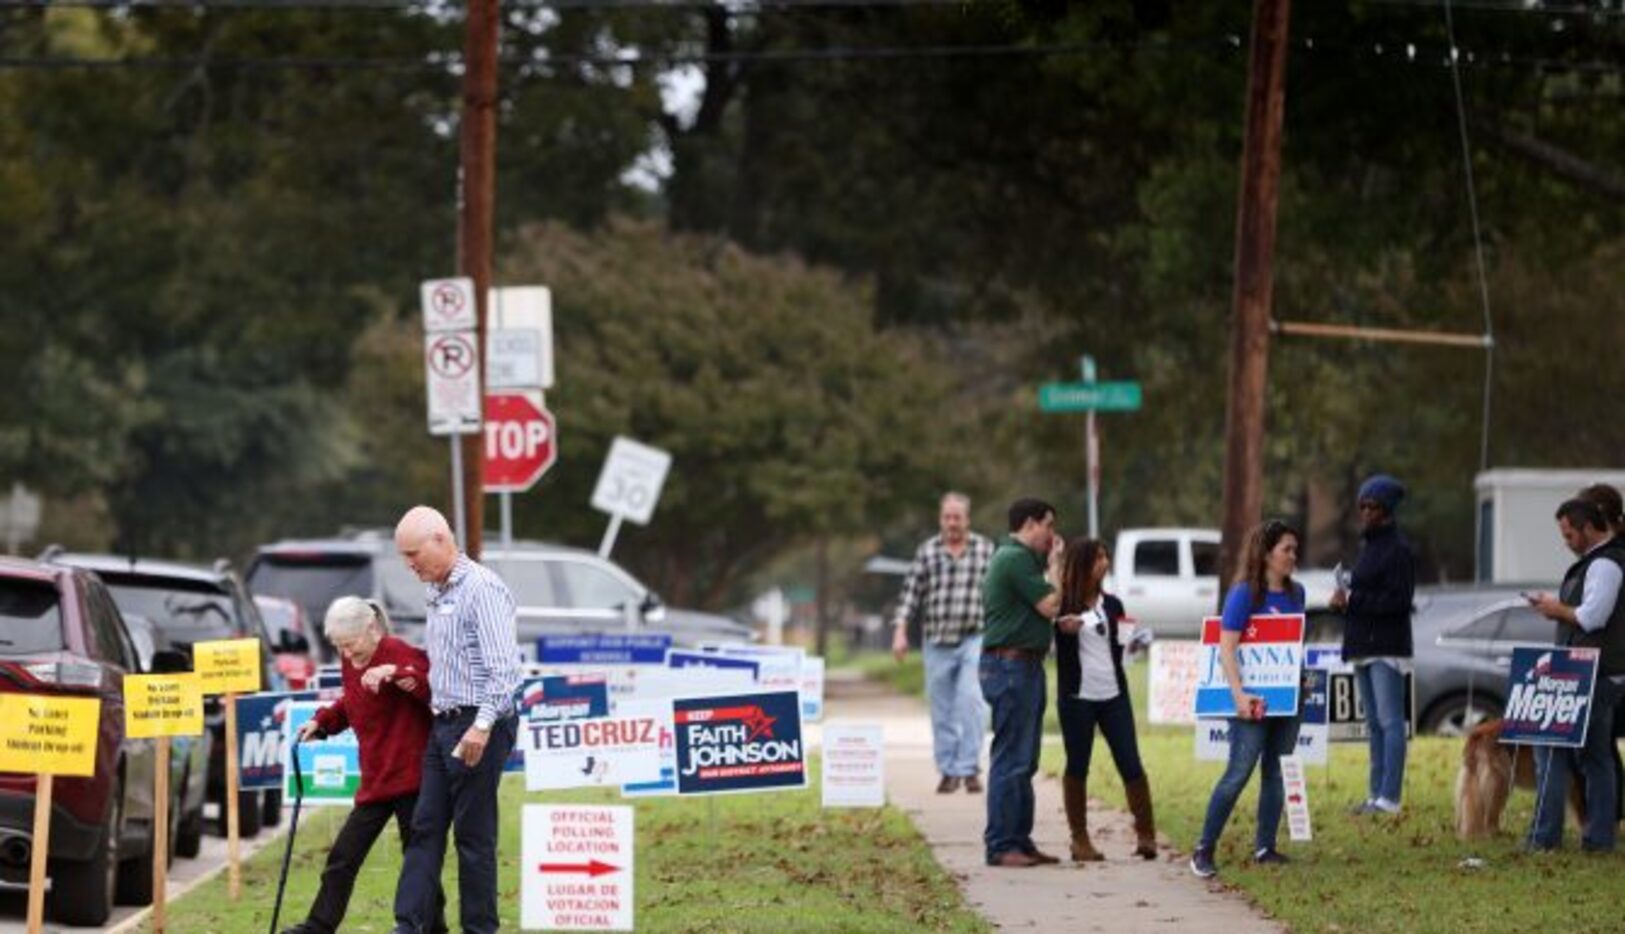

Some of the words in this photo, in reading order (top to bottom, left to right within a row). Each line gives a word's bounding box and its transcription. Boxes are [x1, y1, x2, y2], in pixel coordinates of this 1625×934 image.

[485, 421, 549, 460] TOP
[1200, 645, 1294, 685] JANNA
[1537, 675, 1579, 697] Morgan
[1503, 683, 1588, 730] Meyer
[688, 710, 714, 721] KEEP
[688, 724, 747, 745] FAITH
[681, 739, 799, 775] JOHNSON
[700, 767, 718, 778] OUR
[720, 765, 756, 777] DISTRICT
[758, 761, 802, 774] ATTORNEY
[550, 810, 616, 823] OFFICIAL
[552, 826, 615, 838] POLLING
[546, 841, 619, 853] LOCATION
[546, 884, 596, 896] LUGAR
[600, 884, 618, 896] DE
[546, 899, 620, 911] VOTACION
[554, 914, 611, 926] OFICIAL
